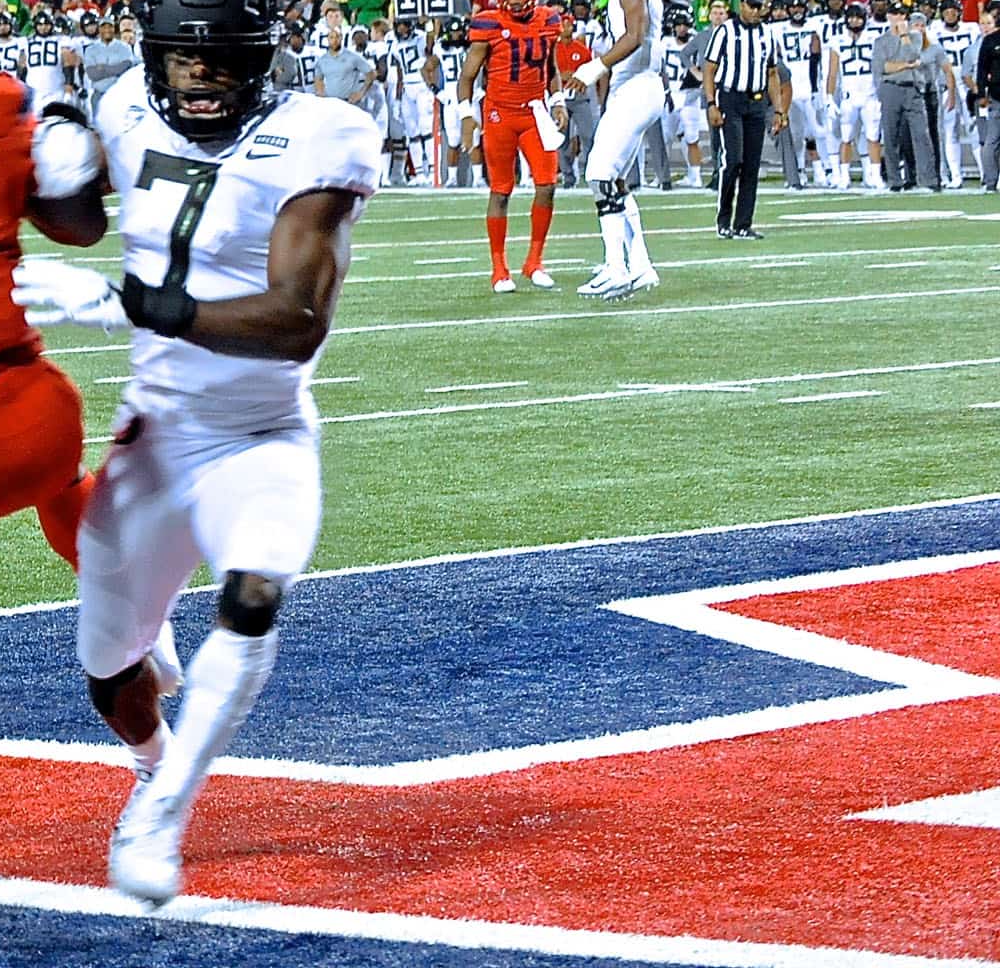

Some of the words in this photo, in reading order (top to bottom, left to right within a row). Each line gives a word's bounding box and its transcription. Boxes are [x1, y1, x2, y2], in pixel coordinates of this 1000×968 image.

[28, 40, 59, 68] 68
[399, 45, 420, 75] 12
[509, 37, 548, 83] 14
[840, 43, 873, 76] 25
[134, 148, 223, 286] 7
